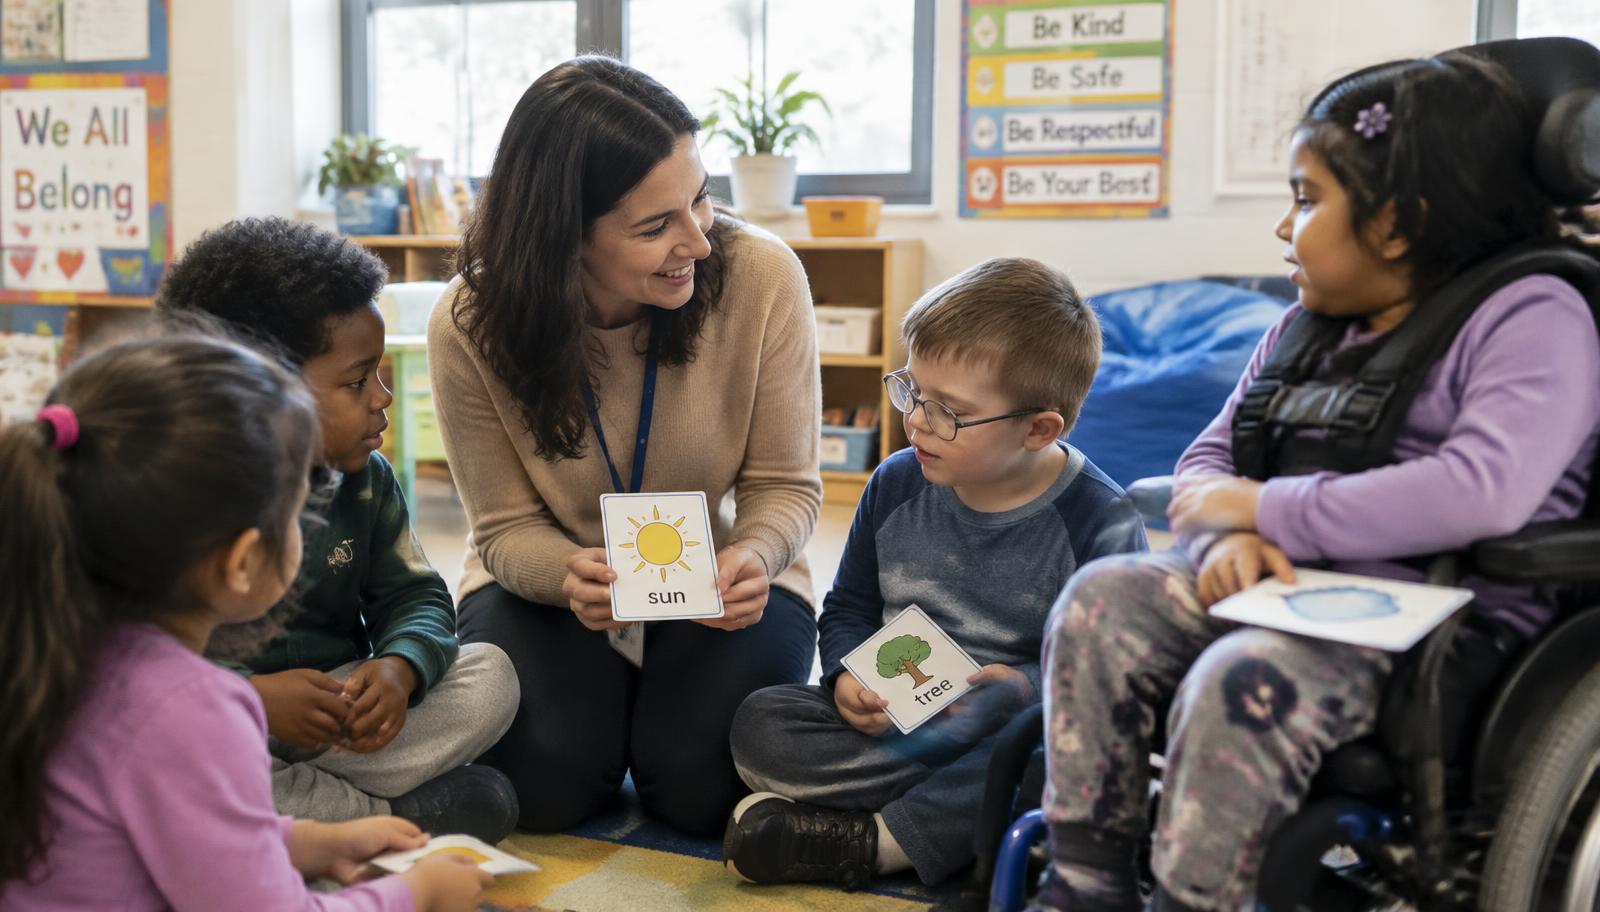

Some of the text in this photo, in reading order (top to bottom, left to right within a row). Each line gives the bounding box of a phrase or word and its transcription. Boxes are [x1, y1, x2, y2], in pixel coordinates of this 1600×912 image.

[1033, 10, 1125, 40] Be Kind
[1032, 63, 1123, 90] Be Safe
[16, 107, 129, 147] We All
[1008, 119, 1034, 142] Be
[14, 164, 132, 222] Belong
[1008, 170, 1152, 195] Be Your Best
[648, 590, 686, 605] sun
[914, 678, 953, 706] tree
